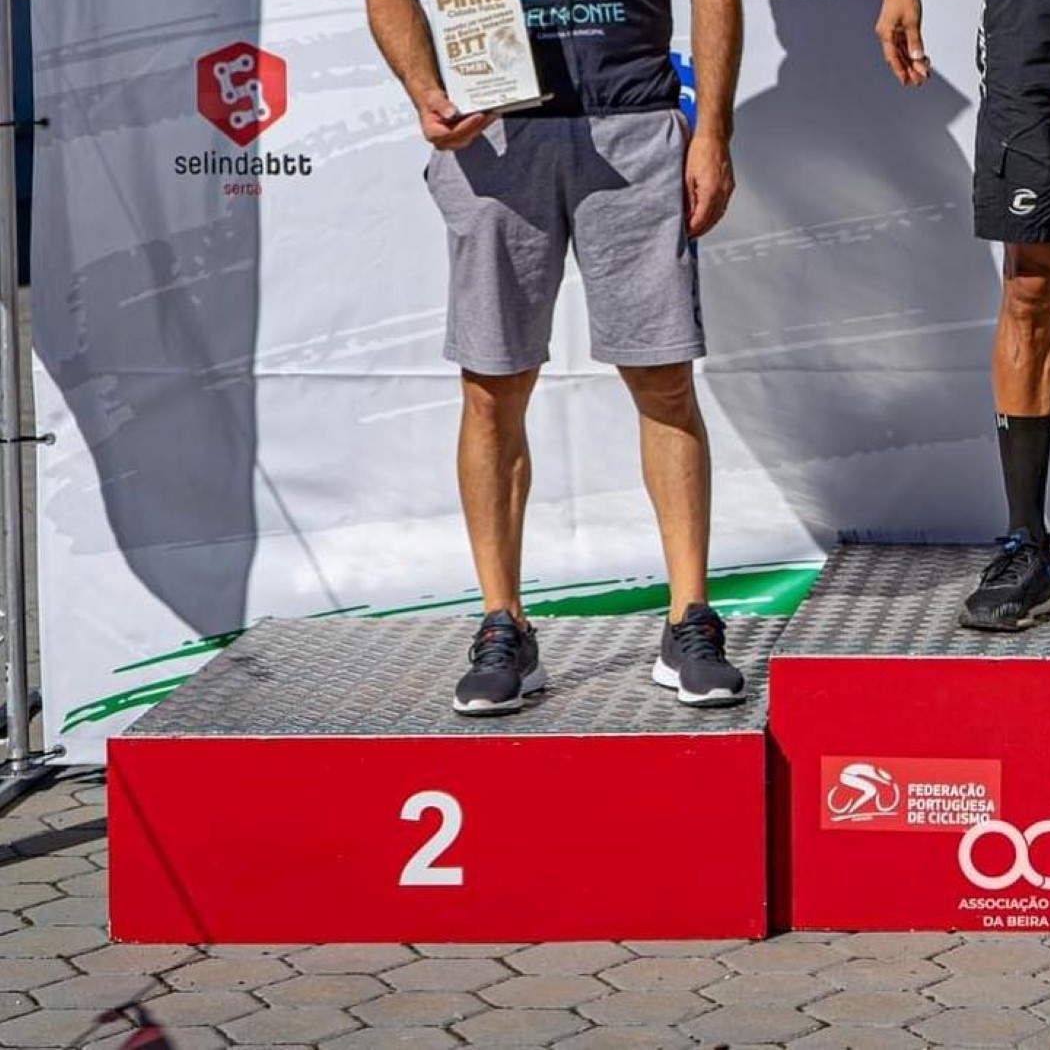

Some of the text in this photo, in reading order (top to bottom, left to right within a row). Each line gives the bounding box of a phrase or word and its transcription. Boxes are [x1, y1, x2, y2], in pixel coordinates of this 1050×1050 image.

[526, 2, 626, 27] ELMONTE
[446, 33, 487, 58] BTT
[174, 150, 313, 176] selindabtt
[907, 783, 986, 799] FEDERAÇÃO
[907, 798, 995, 813] PORTUGUESA
[907, 812, 991, 826] DE CICLISMO
[400, 790, 463, 886] 2
